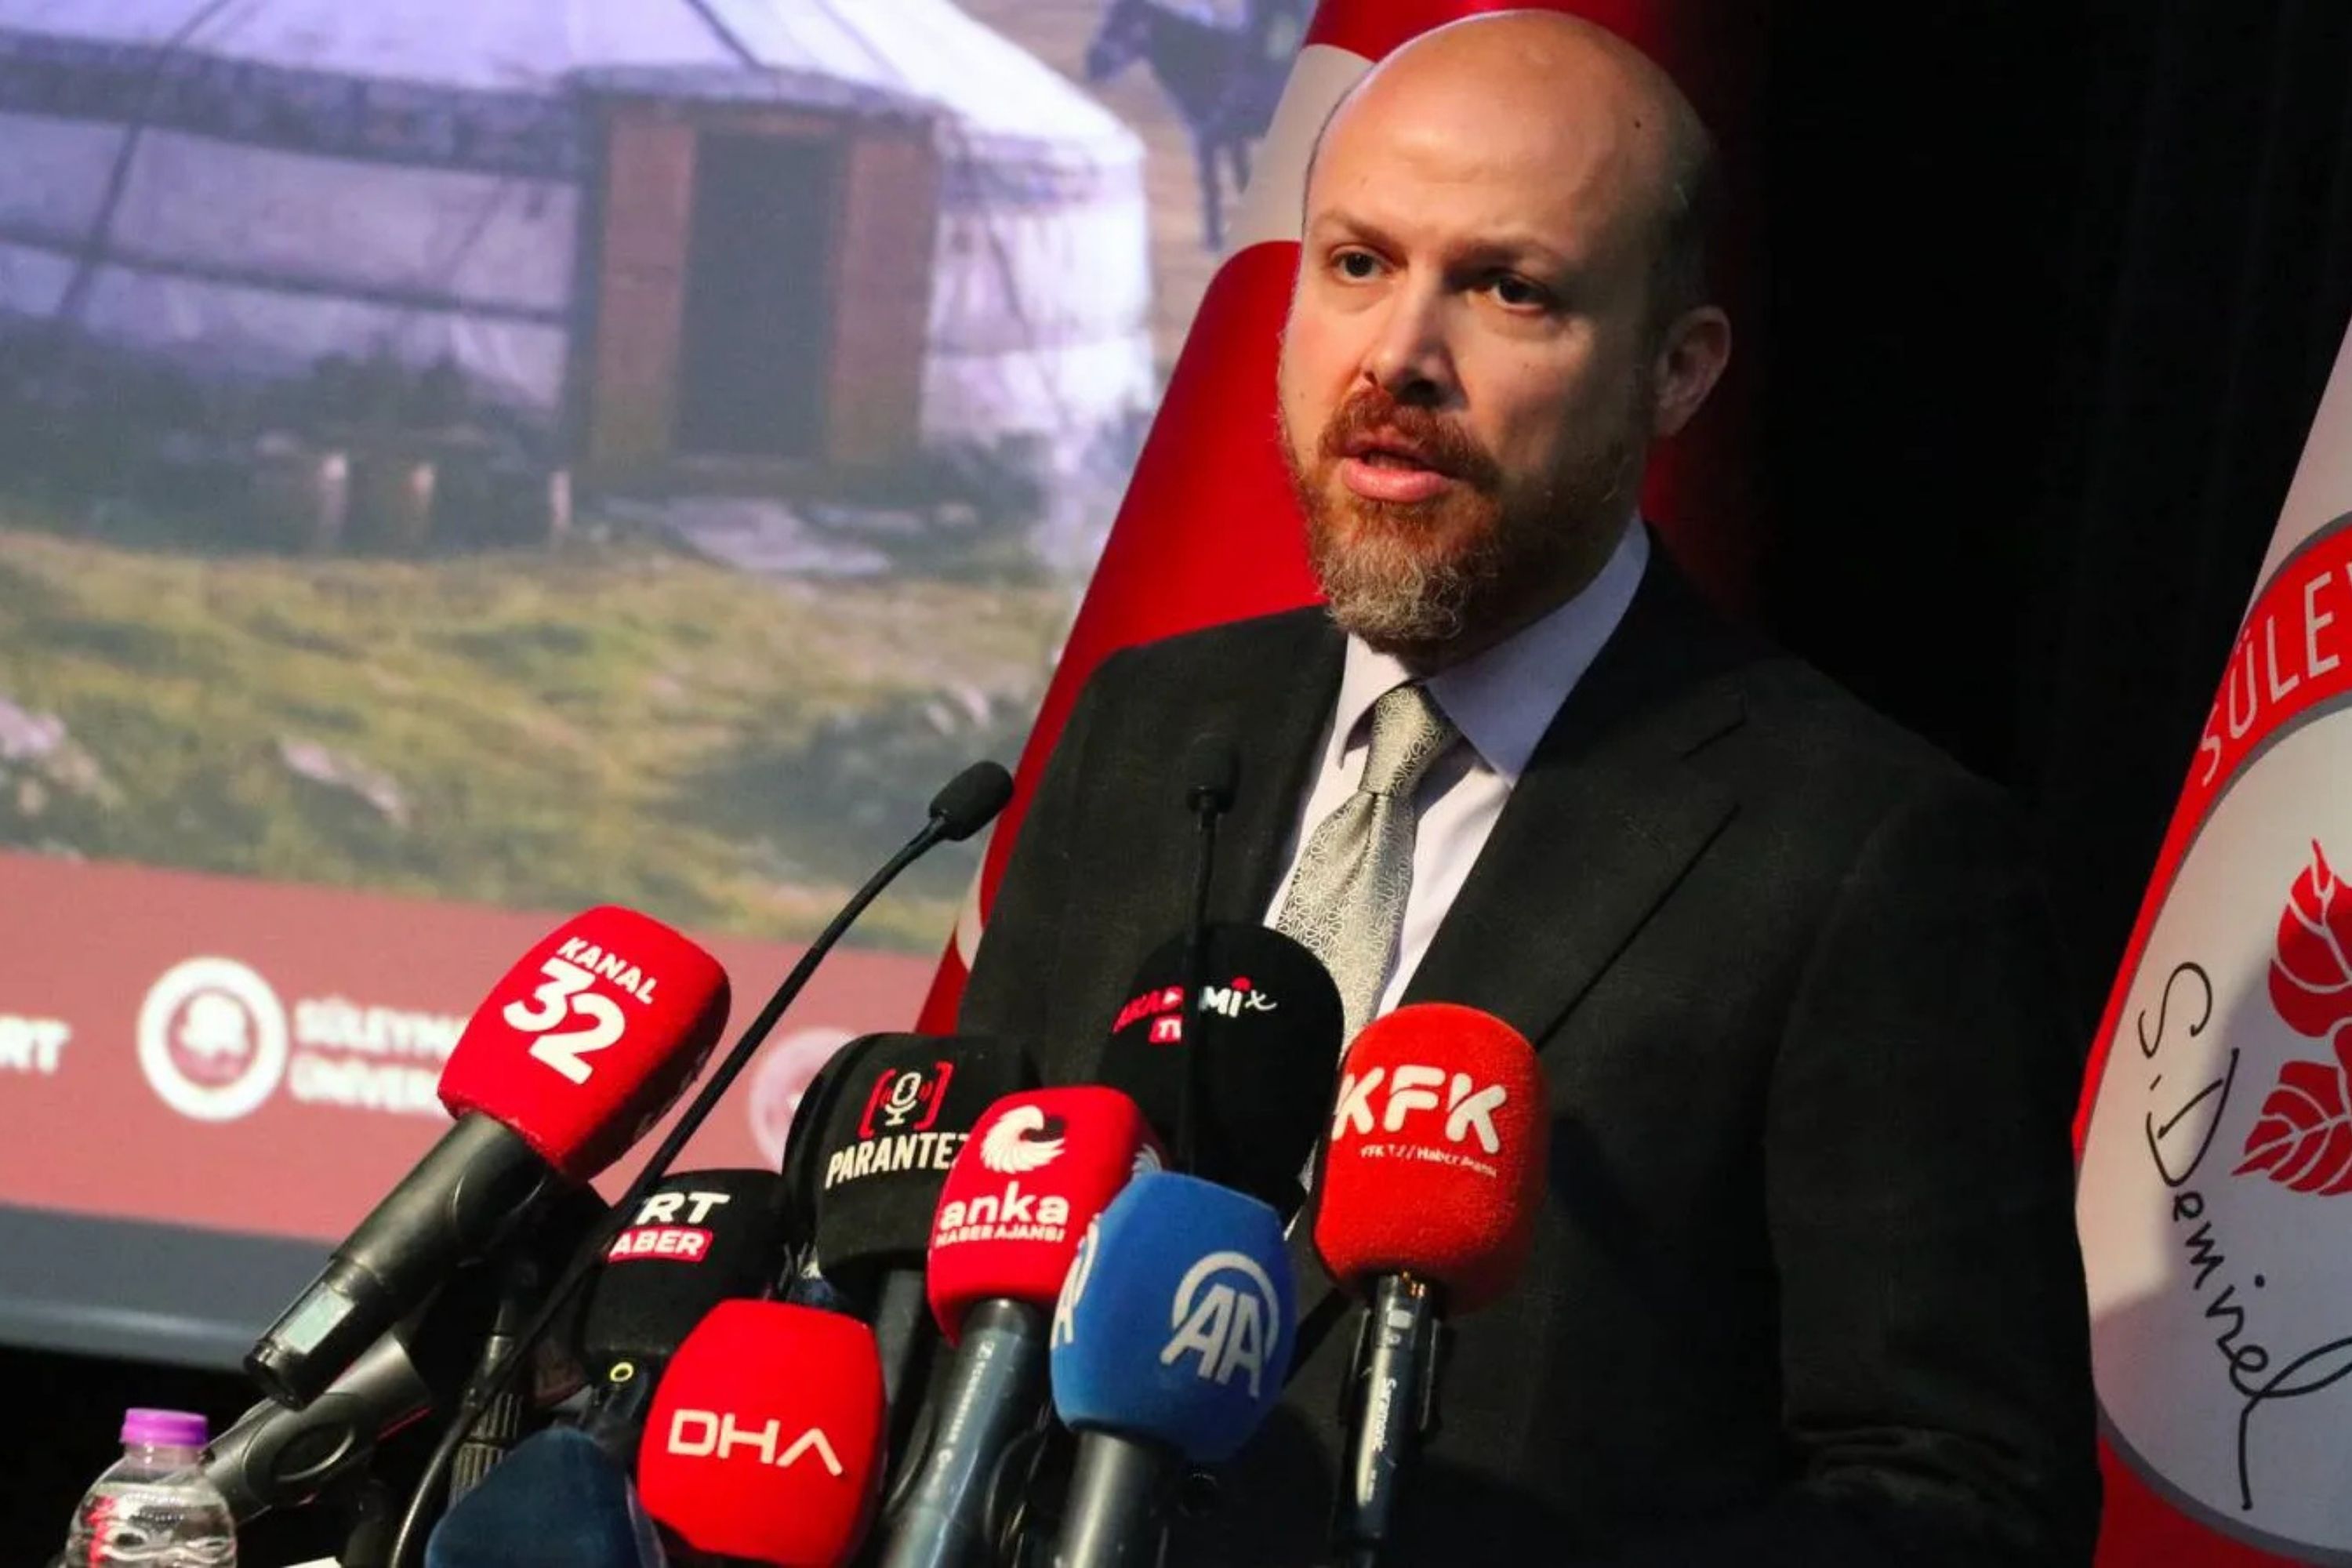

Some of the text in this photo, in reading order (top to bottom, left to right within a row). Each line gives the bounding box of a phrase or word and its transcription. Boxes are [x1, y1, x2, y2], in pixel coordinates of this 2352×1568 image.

[2201, 561, 2352, 786] SÜLE
[557, 937, 657, 1004] KANAL
[503, 957, 626, 1084] 32
[1331, 1065, 1507, 1154] KFK
[636, 1192, 731, 1225] RT
[934, 1225, 994, 1249] HABER
[940, 1181, 1069, 1231] anka
[608, 1229, 705, 1257] ABER
[1160, 1283, 1261, 1398] AA
[667, 1409, 843, 1476] DHA
